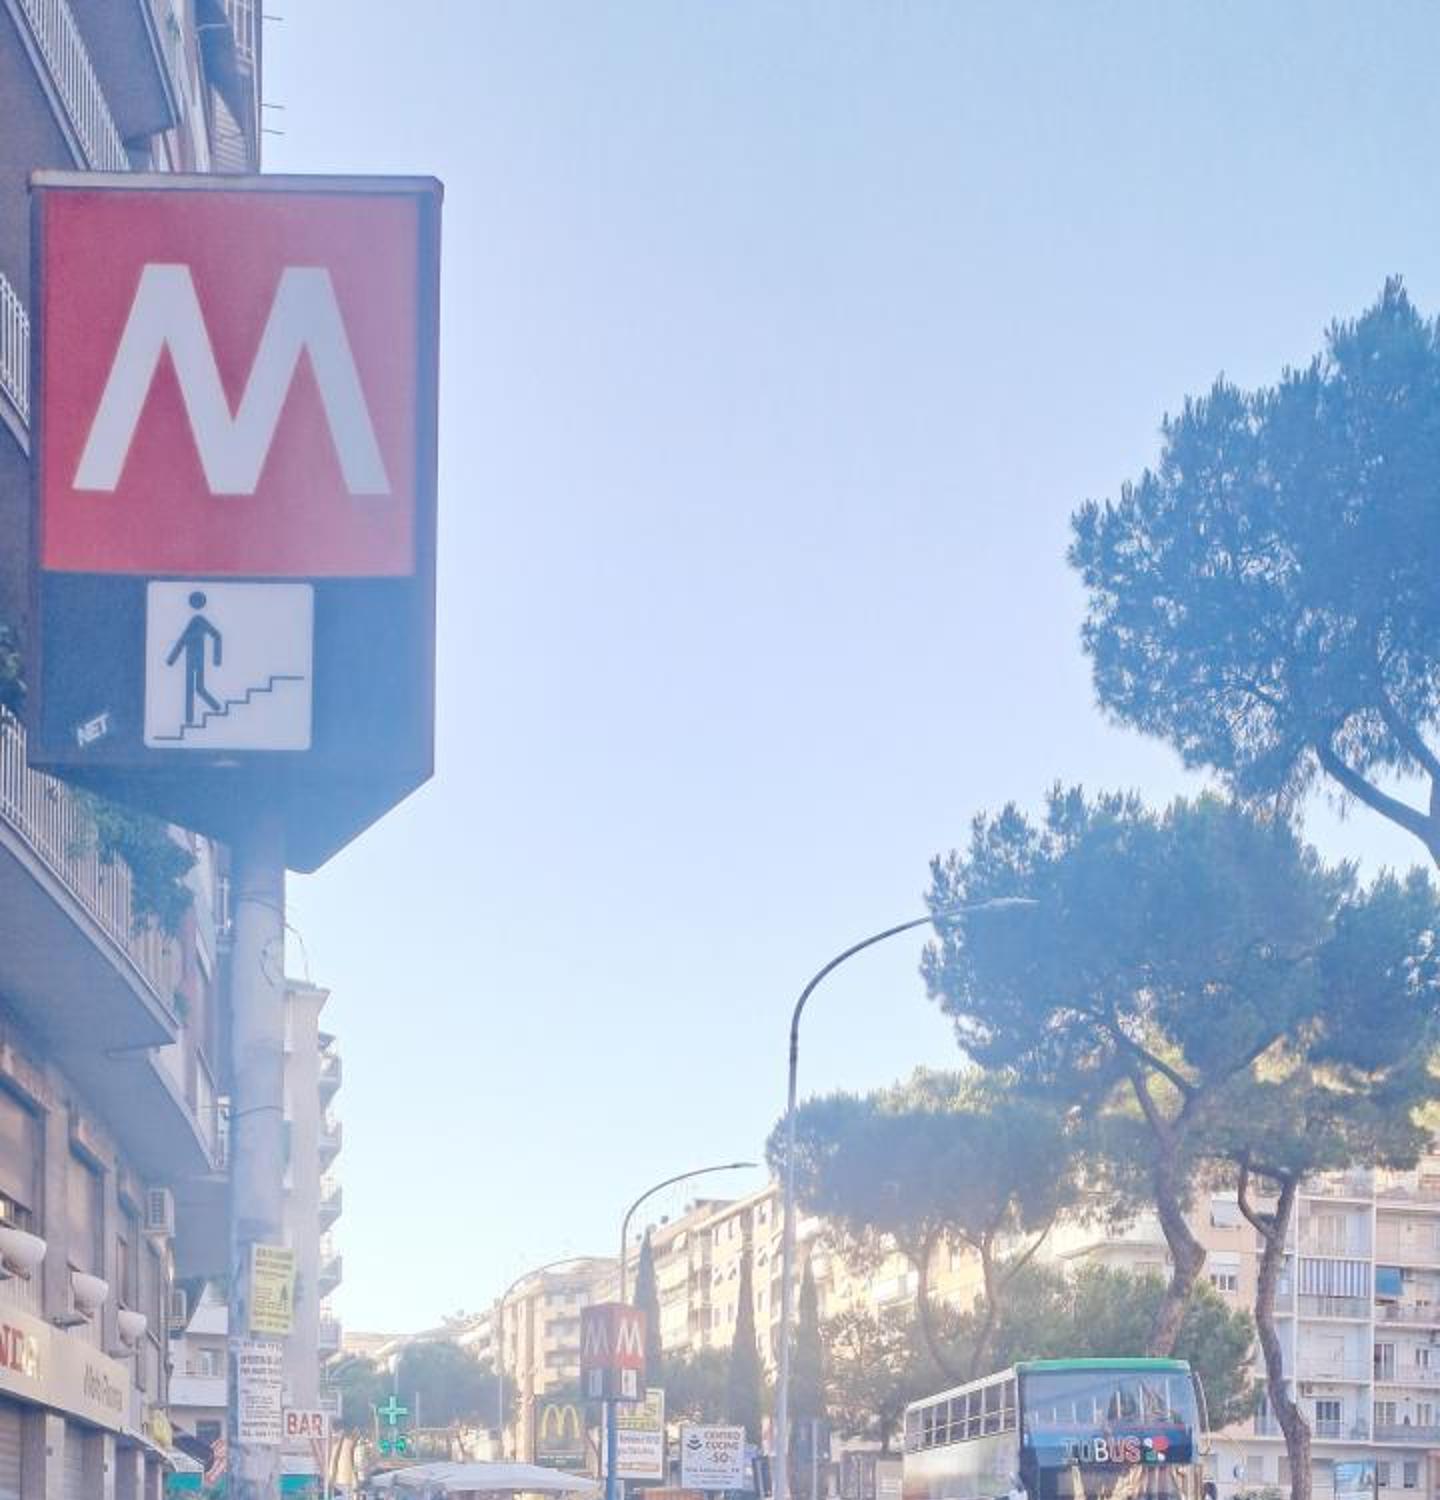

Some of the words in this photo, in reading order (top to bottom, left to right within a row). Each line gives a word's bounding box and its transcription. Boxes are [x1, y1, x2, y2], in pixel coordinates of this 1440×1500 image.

[72, 264, 392, 496] M
[615, 1317, 643, 1357] M
[286, 1412, 323, 1436] BAR
